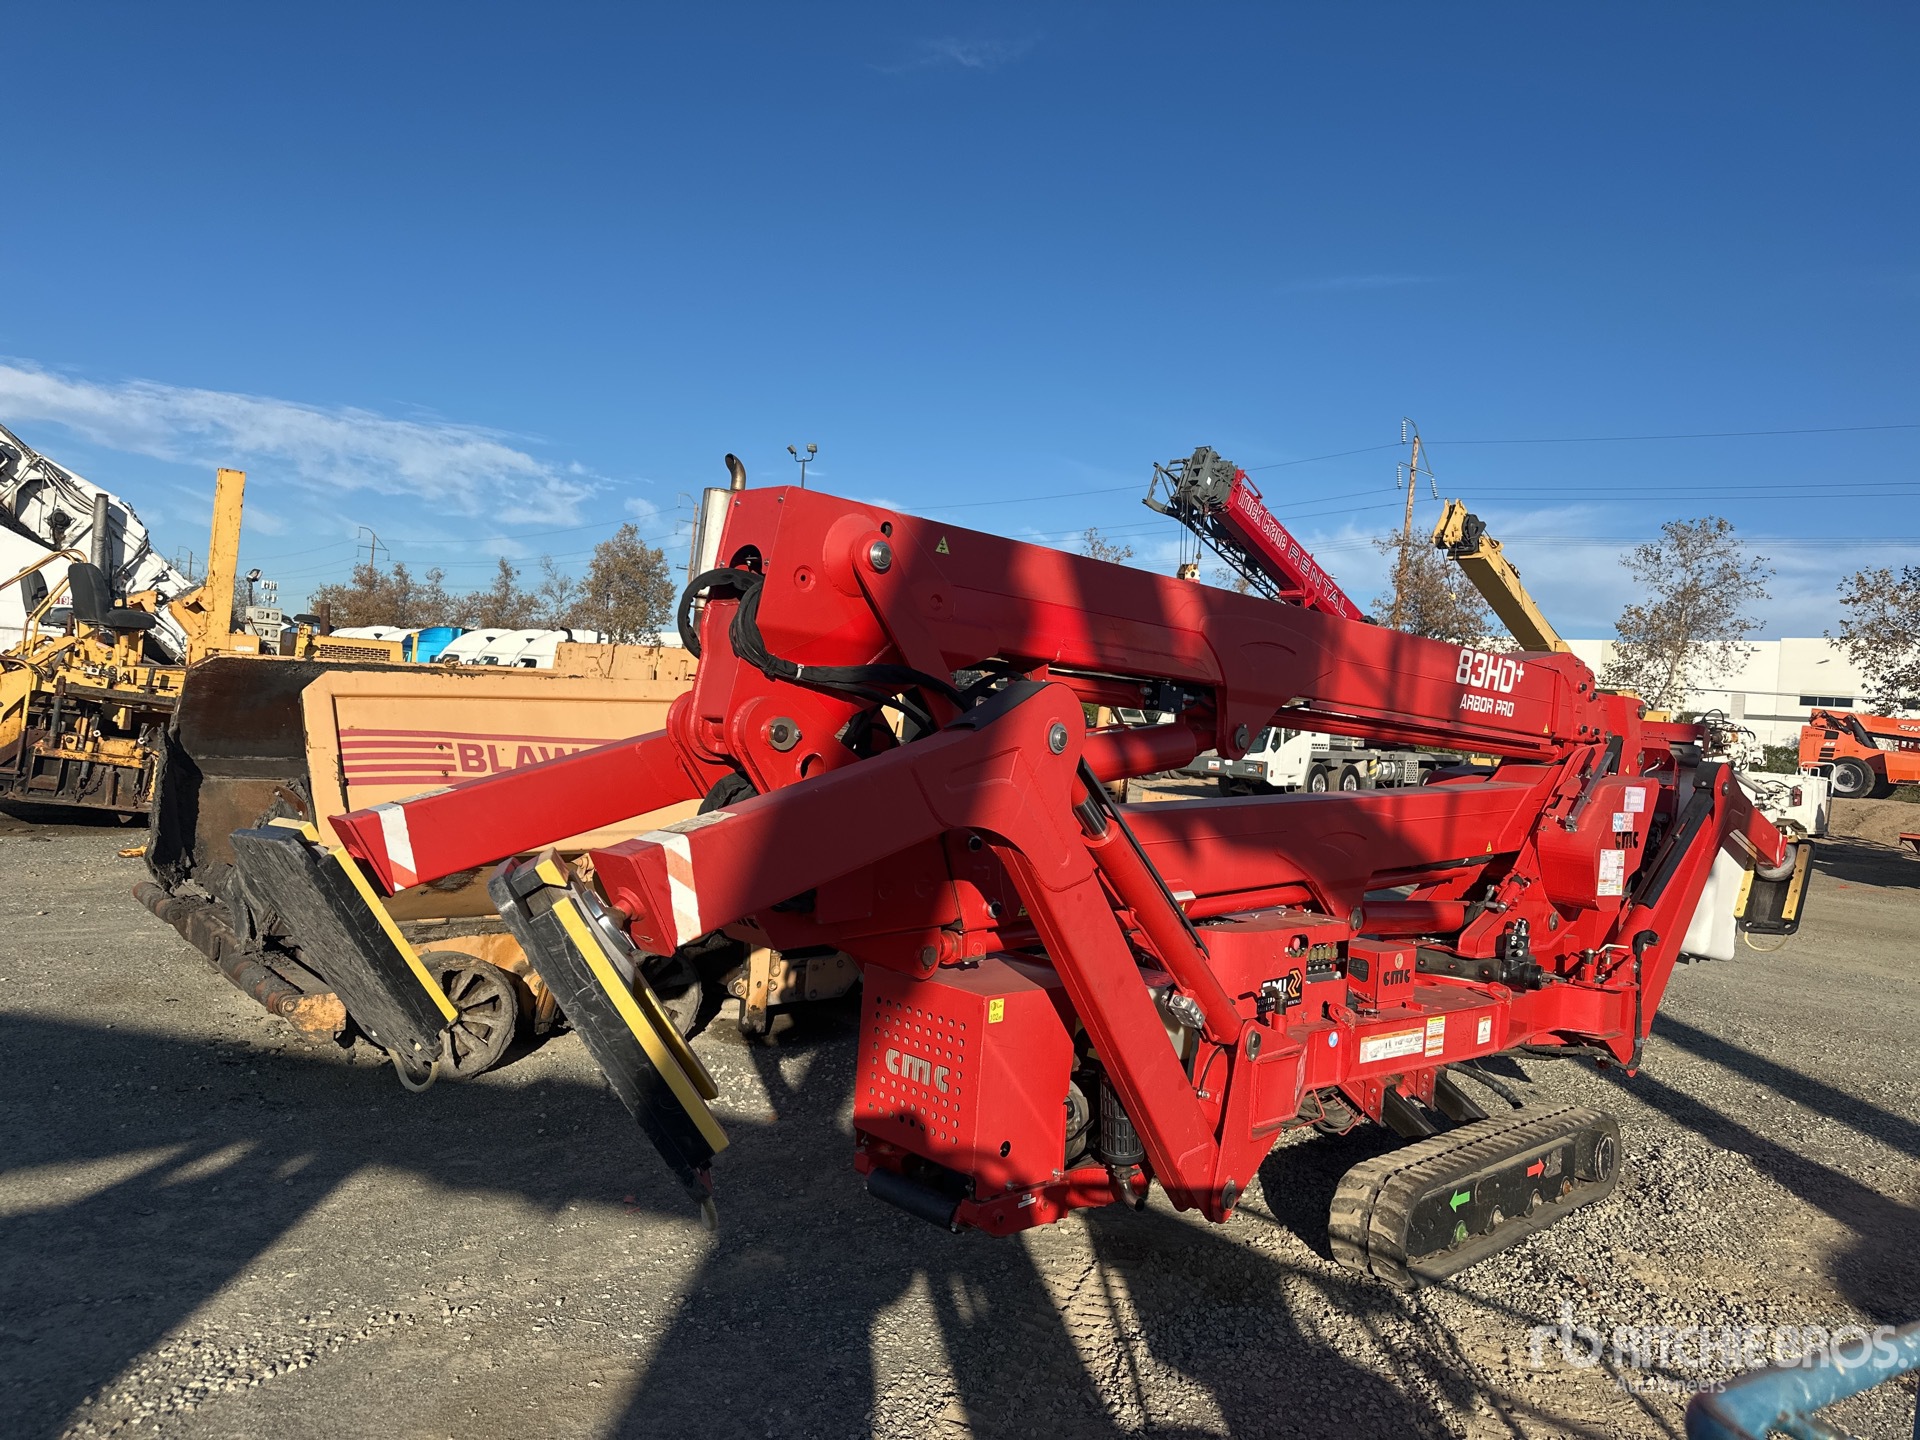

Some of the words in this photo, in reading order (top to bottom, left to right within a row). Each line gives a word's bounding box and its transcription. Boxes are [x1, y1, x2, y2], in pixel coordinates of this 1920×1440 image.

[1238, 484, 1263, 526] Truck
[1262, 510, 1288, 551] Crane
[1288, 543, 1347, 618] RENTAL
[1459, 693, 1494, 714] ARBOR
[1495, 699, 1515, 718] PRO
